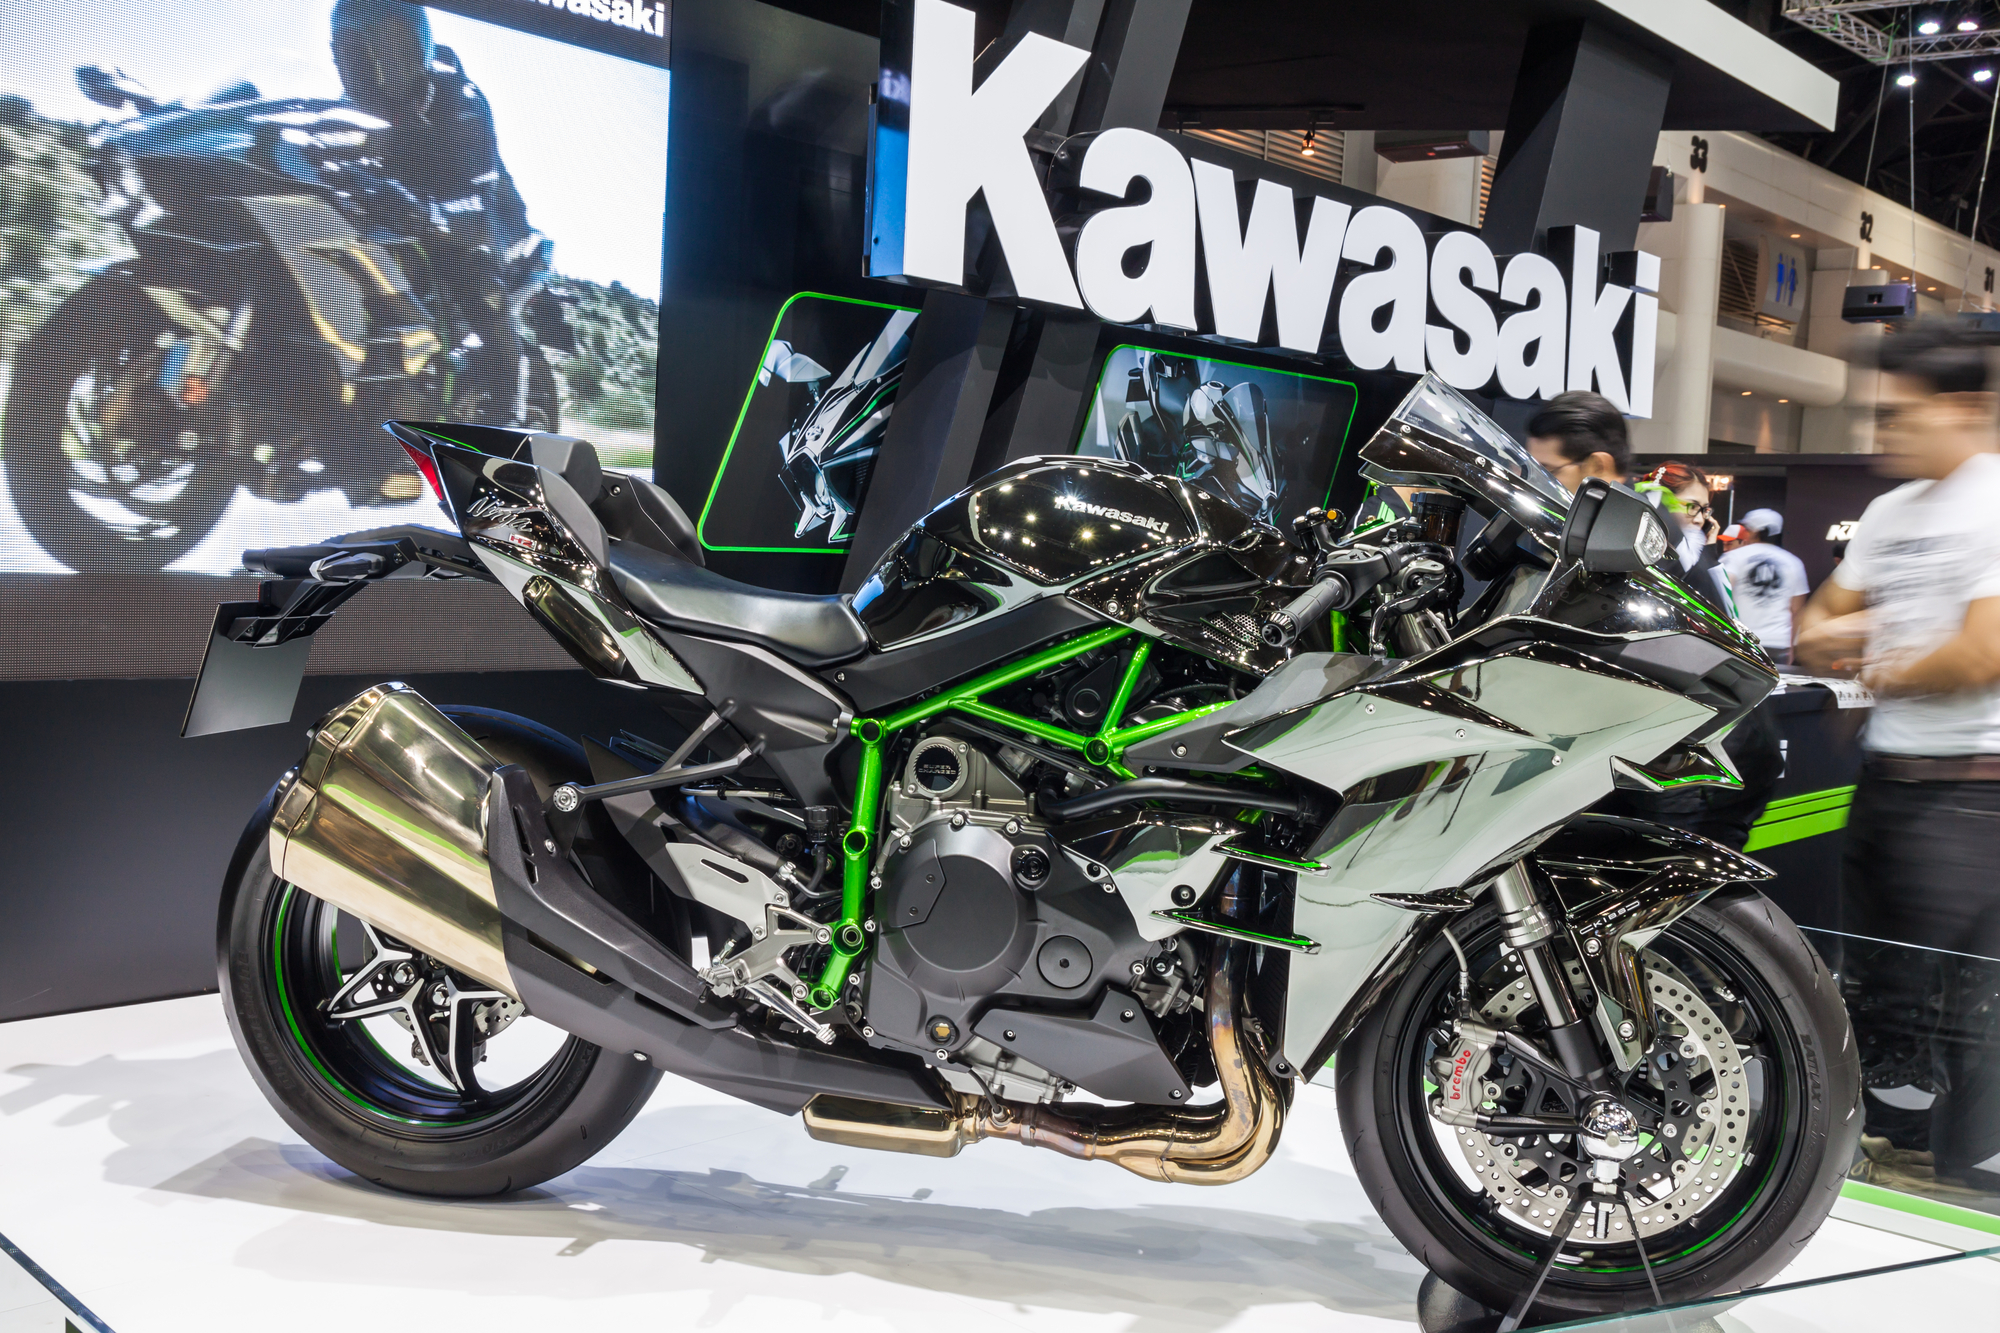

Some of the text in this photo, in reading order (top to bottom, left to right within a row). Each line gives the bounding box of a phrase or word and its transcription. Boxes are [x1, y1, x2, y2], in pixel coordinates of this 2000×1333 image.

[1690, 135, 1709, 174] 33
[903, 0, 1661, 419] Kawasaki
[1860, 211, 1874, 244] 32
[466, 496, 533, 533] Ninja
[1054, 496, 1170, 534] Kawasaki
[1825, 521, 1861, 541] KT
[509, 534, 536, 550] H2
[1450, 1050, 1471, 1100] brembo
